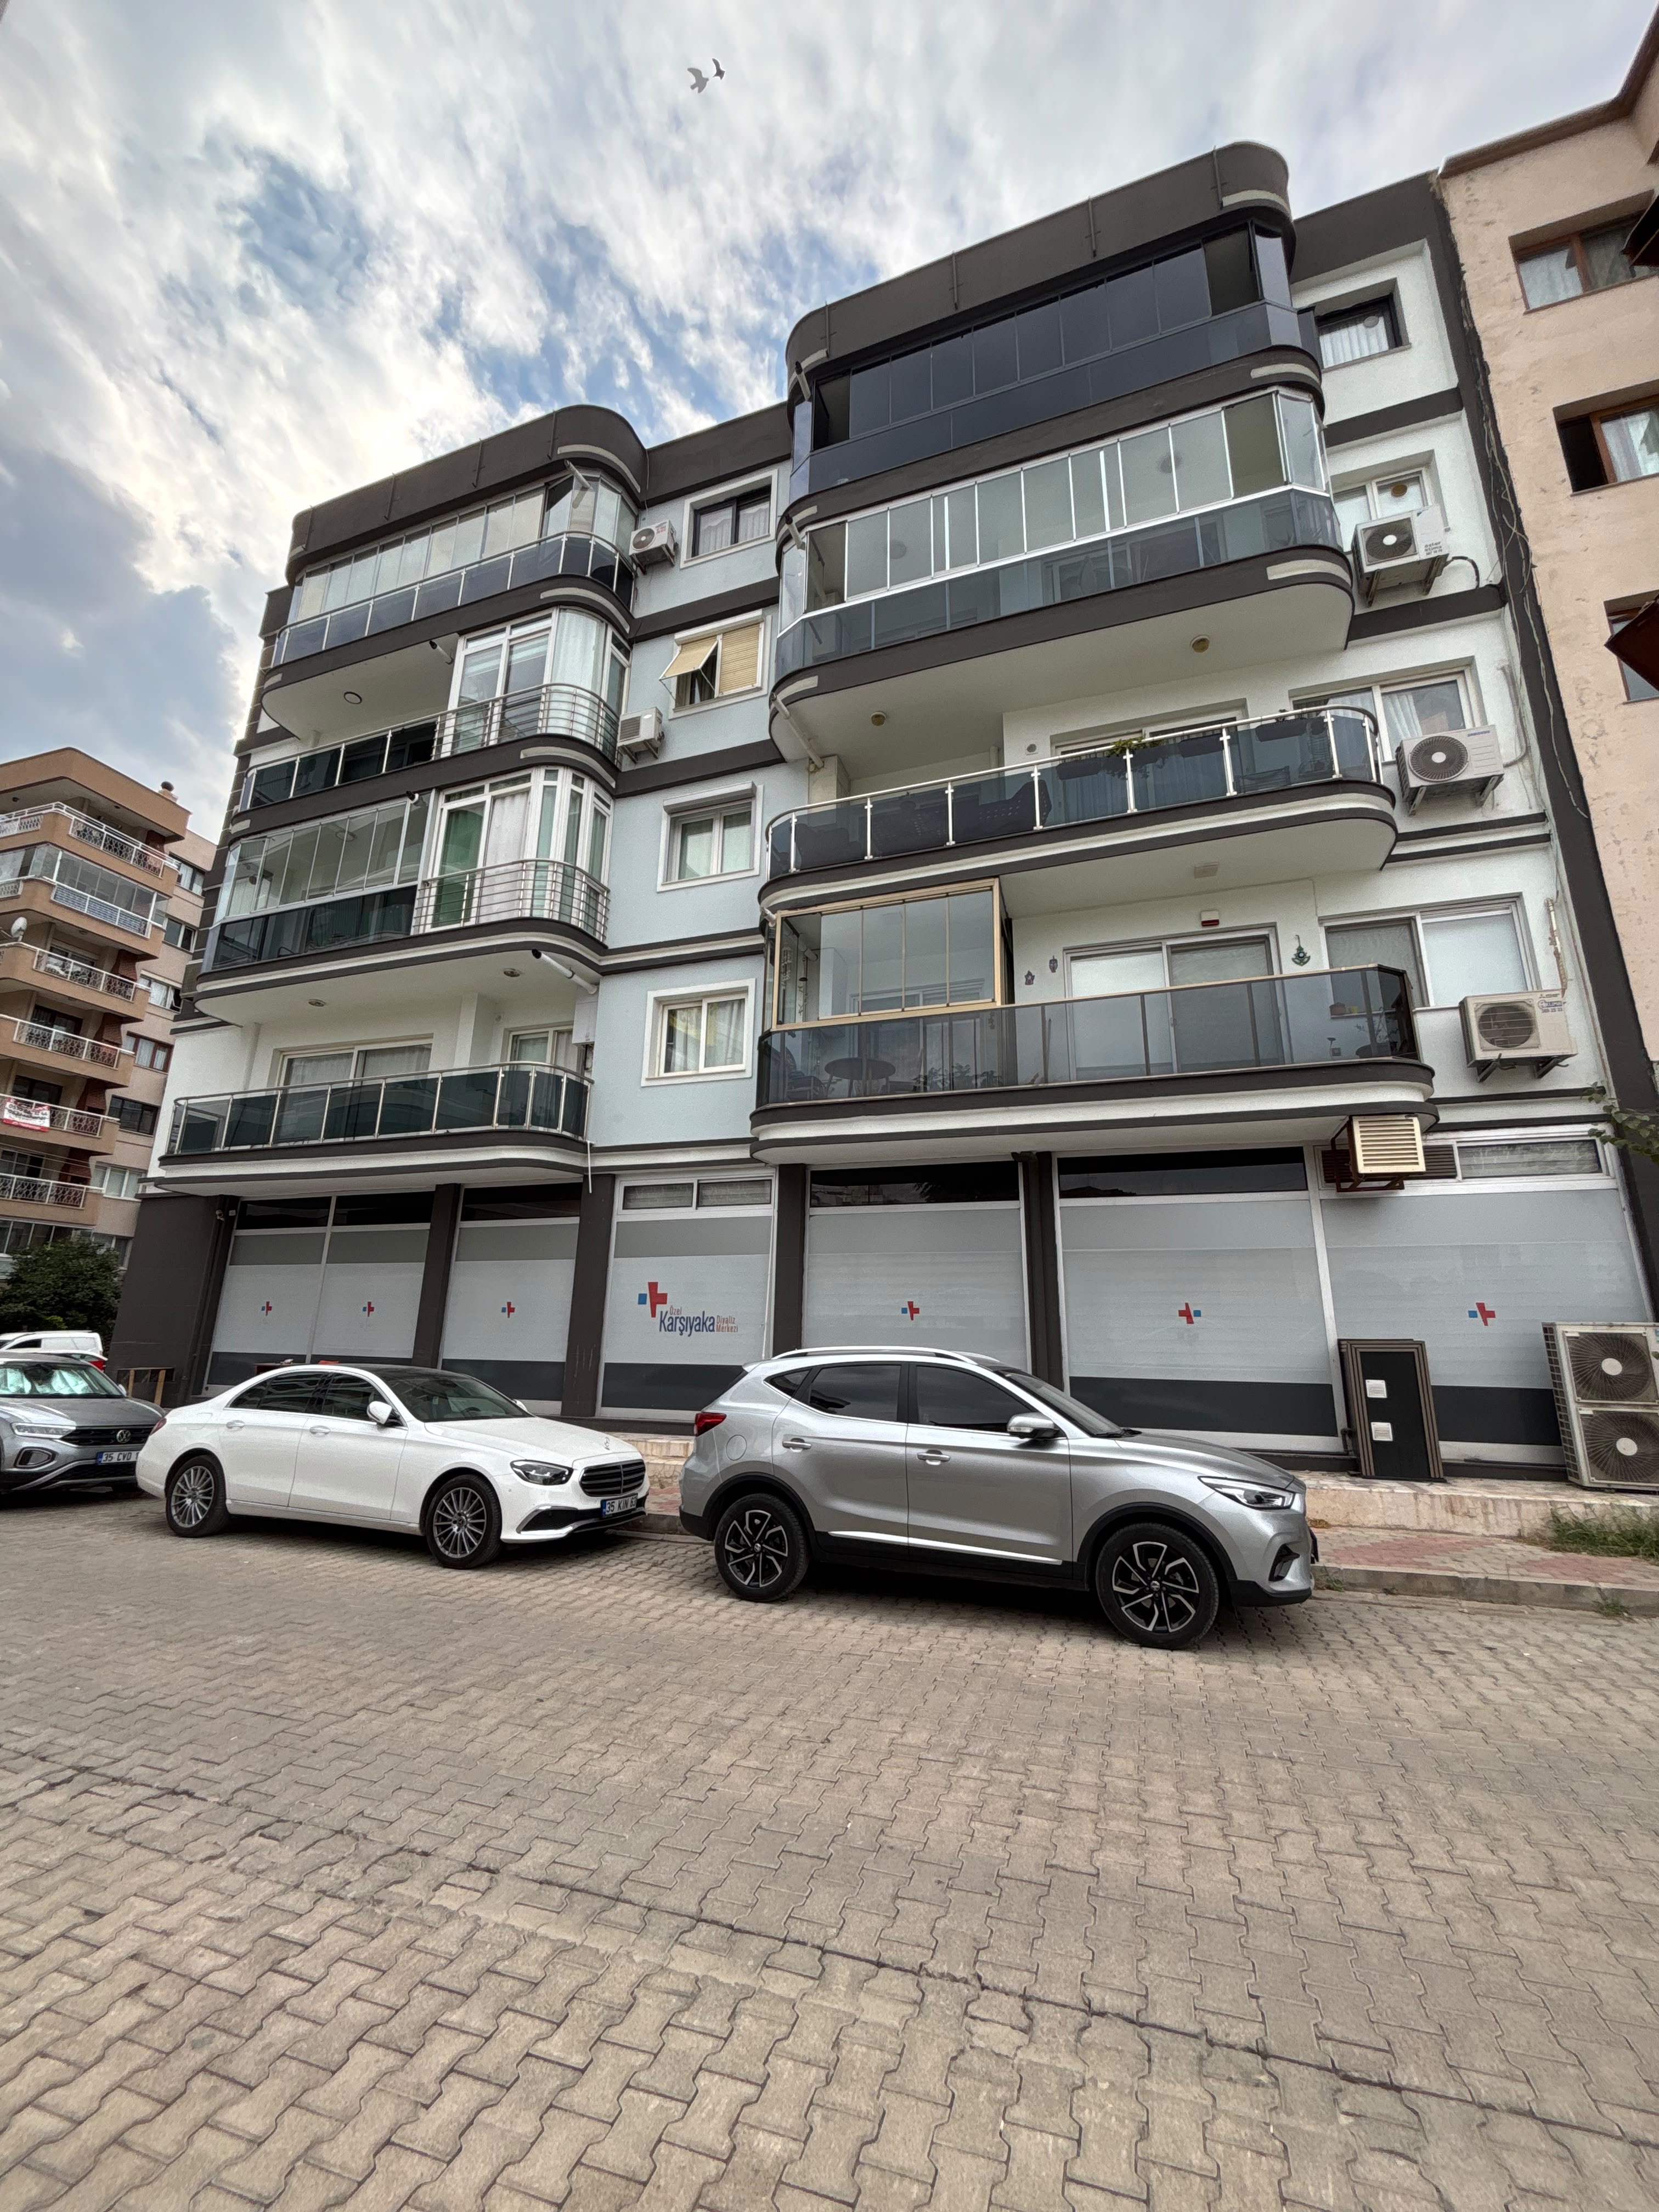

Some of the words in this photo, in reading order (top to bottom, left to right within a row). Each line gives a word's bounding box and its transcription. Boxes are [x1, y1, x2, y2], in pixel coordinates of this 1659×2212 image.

[669, 1305, 682, 1315] Özel
[659, 1310, 715, 1337] Karşıyaka
[716, 1315, 736, 1325] Diyaliz
[716, 1324, 738, 1333] Merkezi
[103, 1453, 114, 1462] 35
[117, 1452, 132, 1461] CVD
[606, 1501, 615, 1513] 35
[617, 1499, 629, 1511] KIN
[630, 1497, 636, 1508] 63
